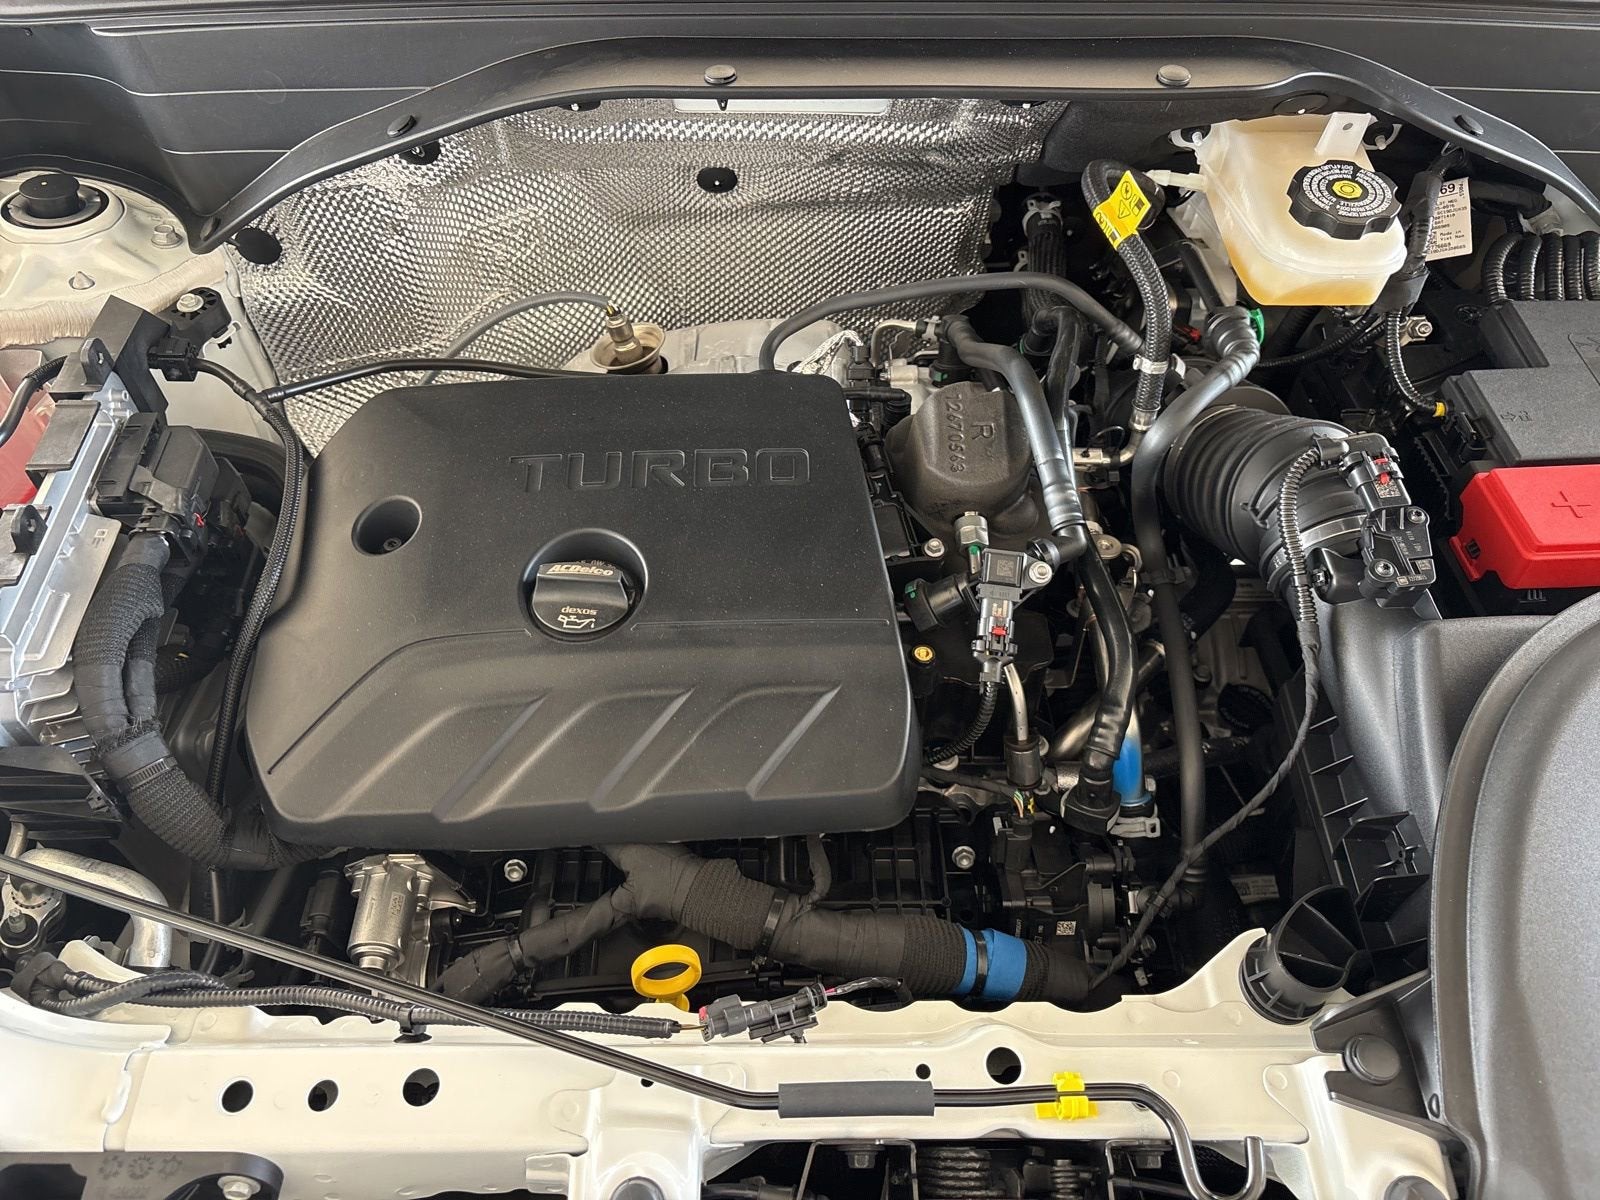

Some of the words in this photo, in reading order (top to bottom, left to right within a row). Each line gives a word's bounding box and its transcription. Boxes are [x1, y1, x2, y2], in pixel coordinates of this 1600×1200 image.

[970, 422, 995, 441] R
[508, 447, 810, 493] TURBO
[546, 564, 614, 577] ACDelco
[561, 605, 599, 616] dexos
